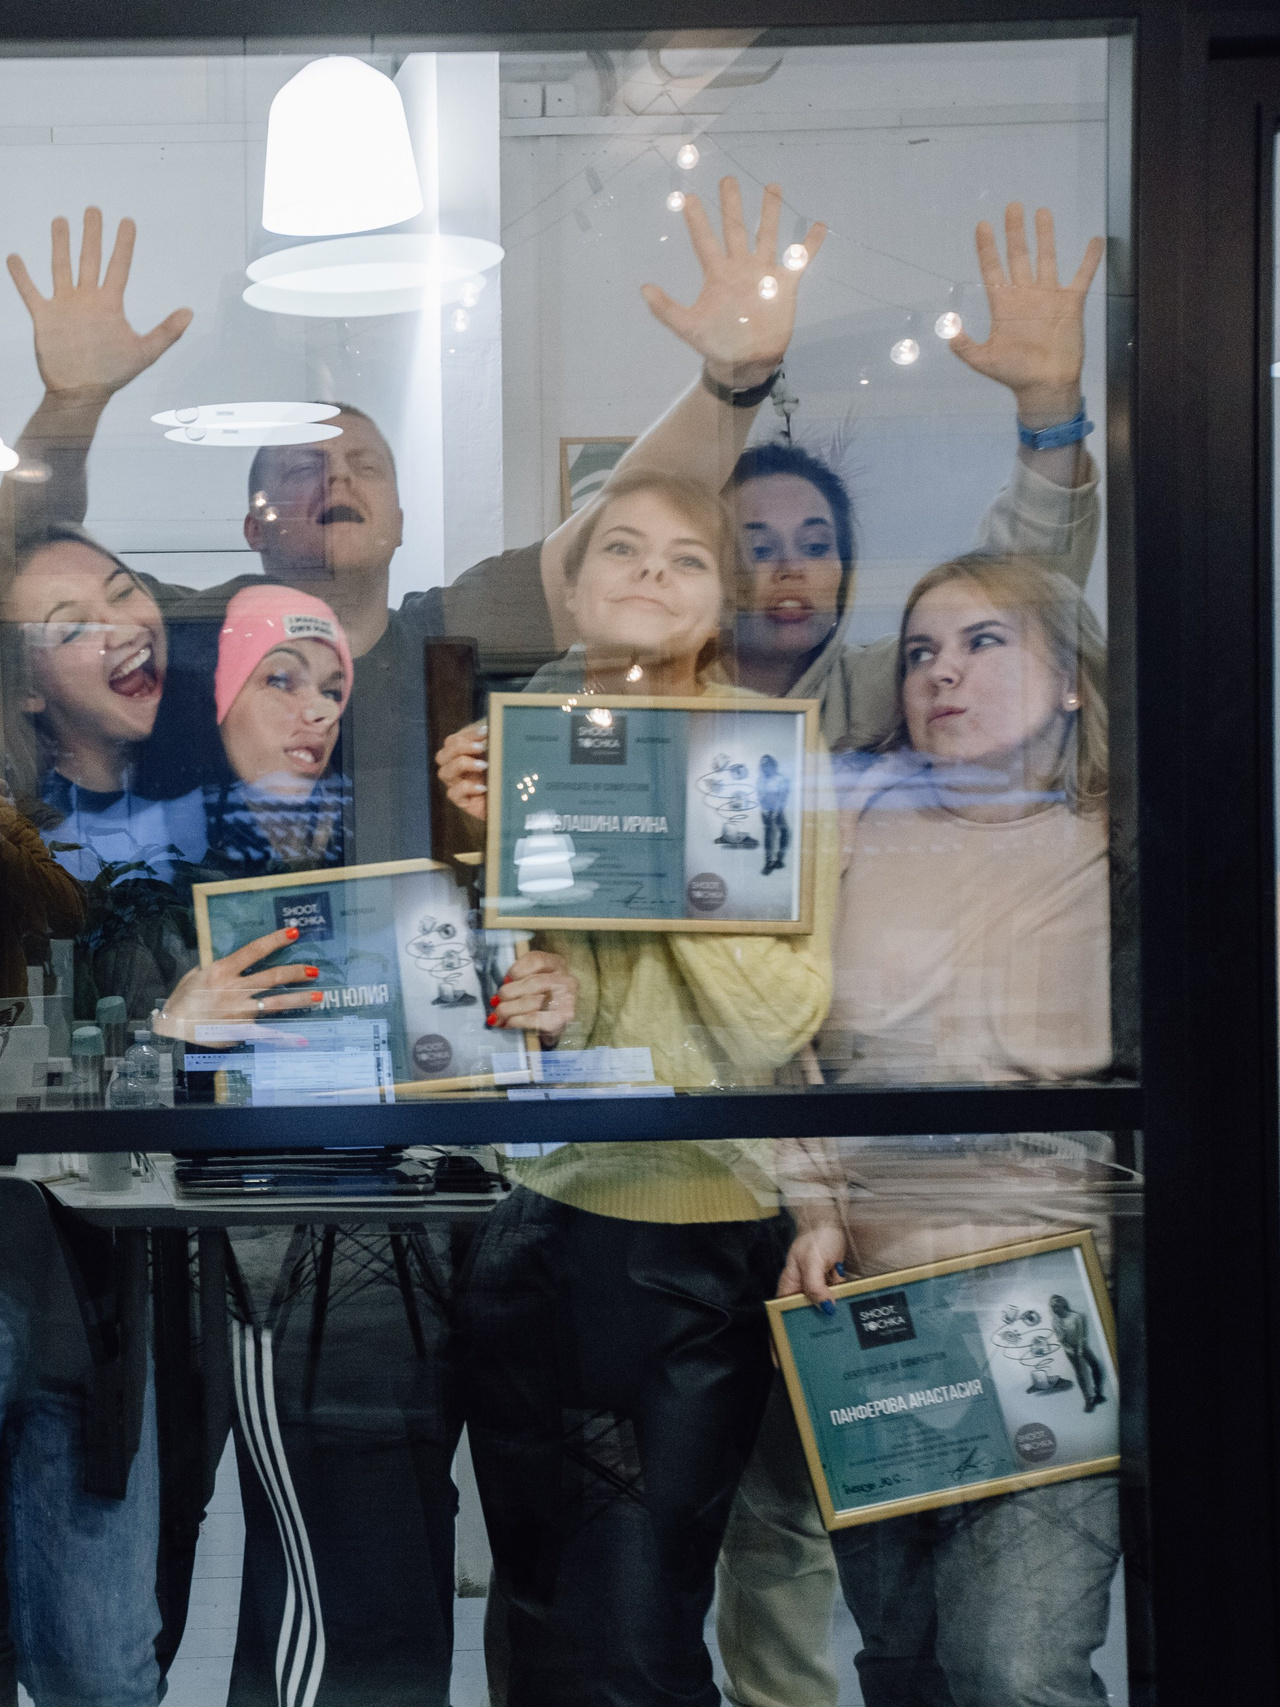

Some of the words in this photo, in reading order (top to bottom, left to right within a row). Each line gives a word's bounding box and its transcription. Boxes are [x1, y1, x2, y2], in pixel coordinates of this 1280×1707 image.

[622, 815, 668, 833] ИРИНА
[343, 984, 389, 1007] ЮЛИЯ
[829, 1396, 909, 1426] ПАНФЕРОВА
[909, 1379, 983, 1408] АНАСТАСИЯ
